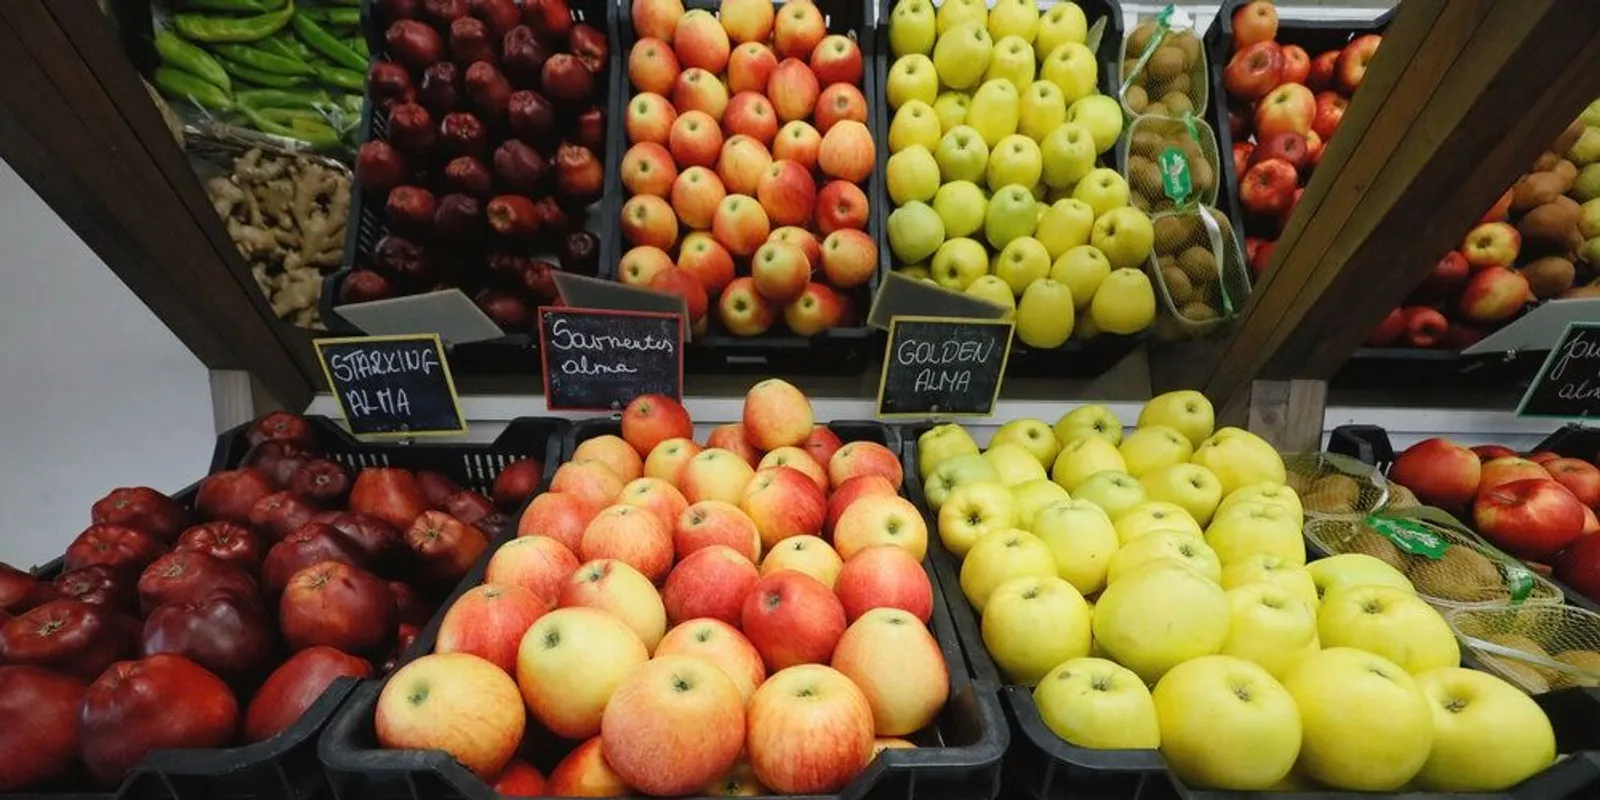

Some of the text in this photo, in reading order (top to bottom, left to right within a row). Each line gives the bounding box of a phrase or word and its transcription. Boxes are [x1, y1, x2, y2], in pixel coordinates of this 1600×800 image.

[897, 337, 995, 365] GOLDEN
[561, 355, 638, 375] alma
[915, 368, 971, 392] ALMA
[346, 387, 411, 417] ALMA
